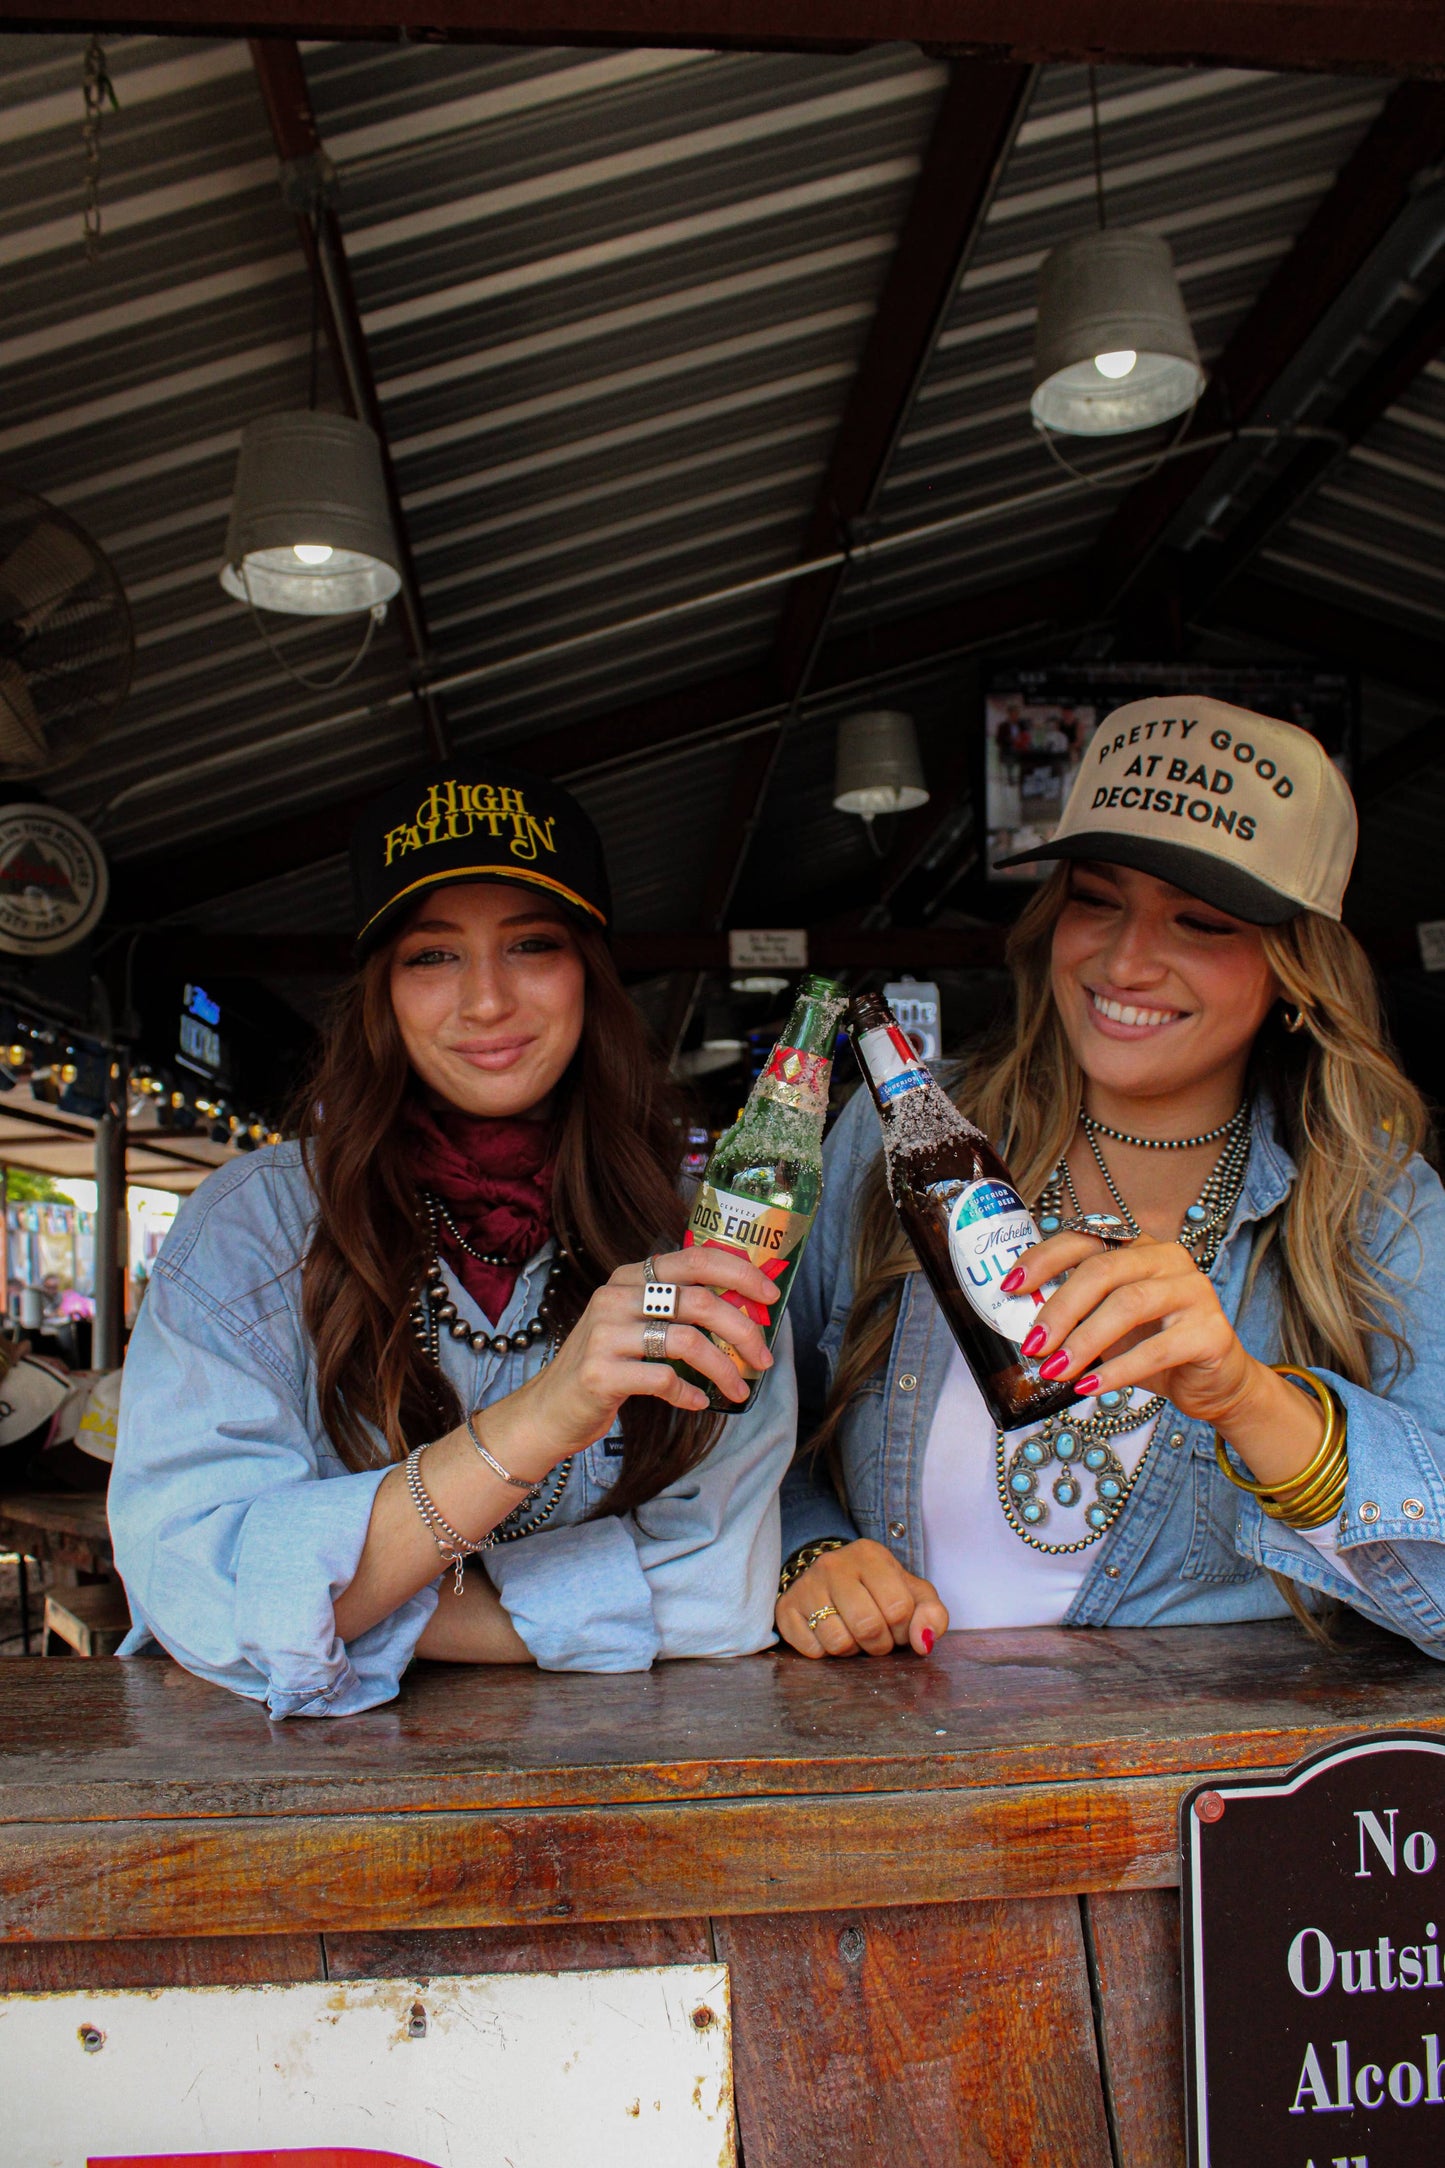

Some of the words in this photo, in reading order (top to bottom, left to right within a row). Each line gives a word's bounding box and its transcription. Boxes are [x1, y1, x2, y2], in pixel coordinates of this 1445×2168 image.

[1099, 719, 1198, 764] PRETTY
[1210, 729, 1294, 799] GOOD
[1124, 754, 1163, 778] AT
[1166, 758, 1235, 795] BAD
[416, 779, 529, 830] HIGH
[1091, 786, 1257, 842] DECISIONS
[720, 1202, 757, 1218] CERVEZA
[968, 1188, 1010, 1206] SUPERIOR
[968, 1203, 996, 1218] LIGHT
[998, 1196, 1017, 1208] BEER
[693, 1204, 722, 1232] DOS
[723, 1215, 784, 1250] EQUIS
[974, 1220, 1033, 1255] Michelob
[966, 1241, 1037, 1287] ULT
[1353, 1808, 1437, 1878] No
[1287, 1922, 1445, 1997] Outsi
